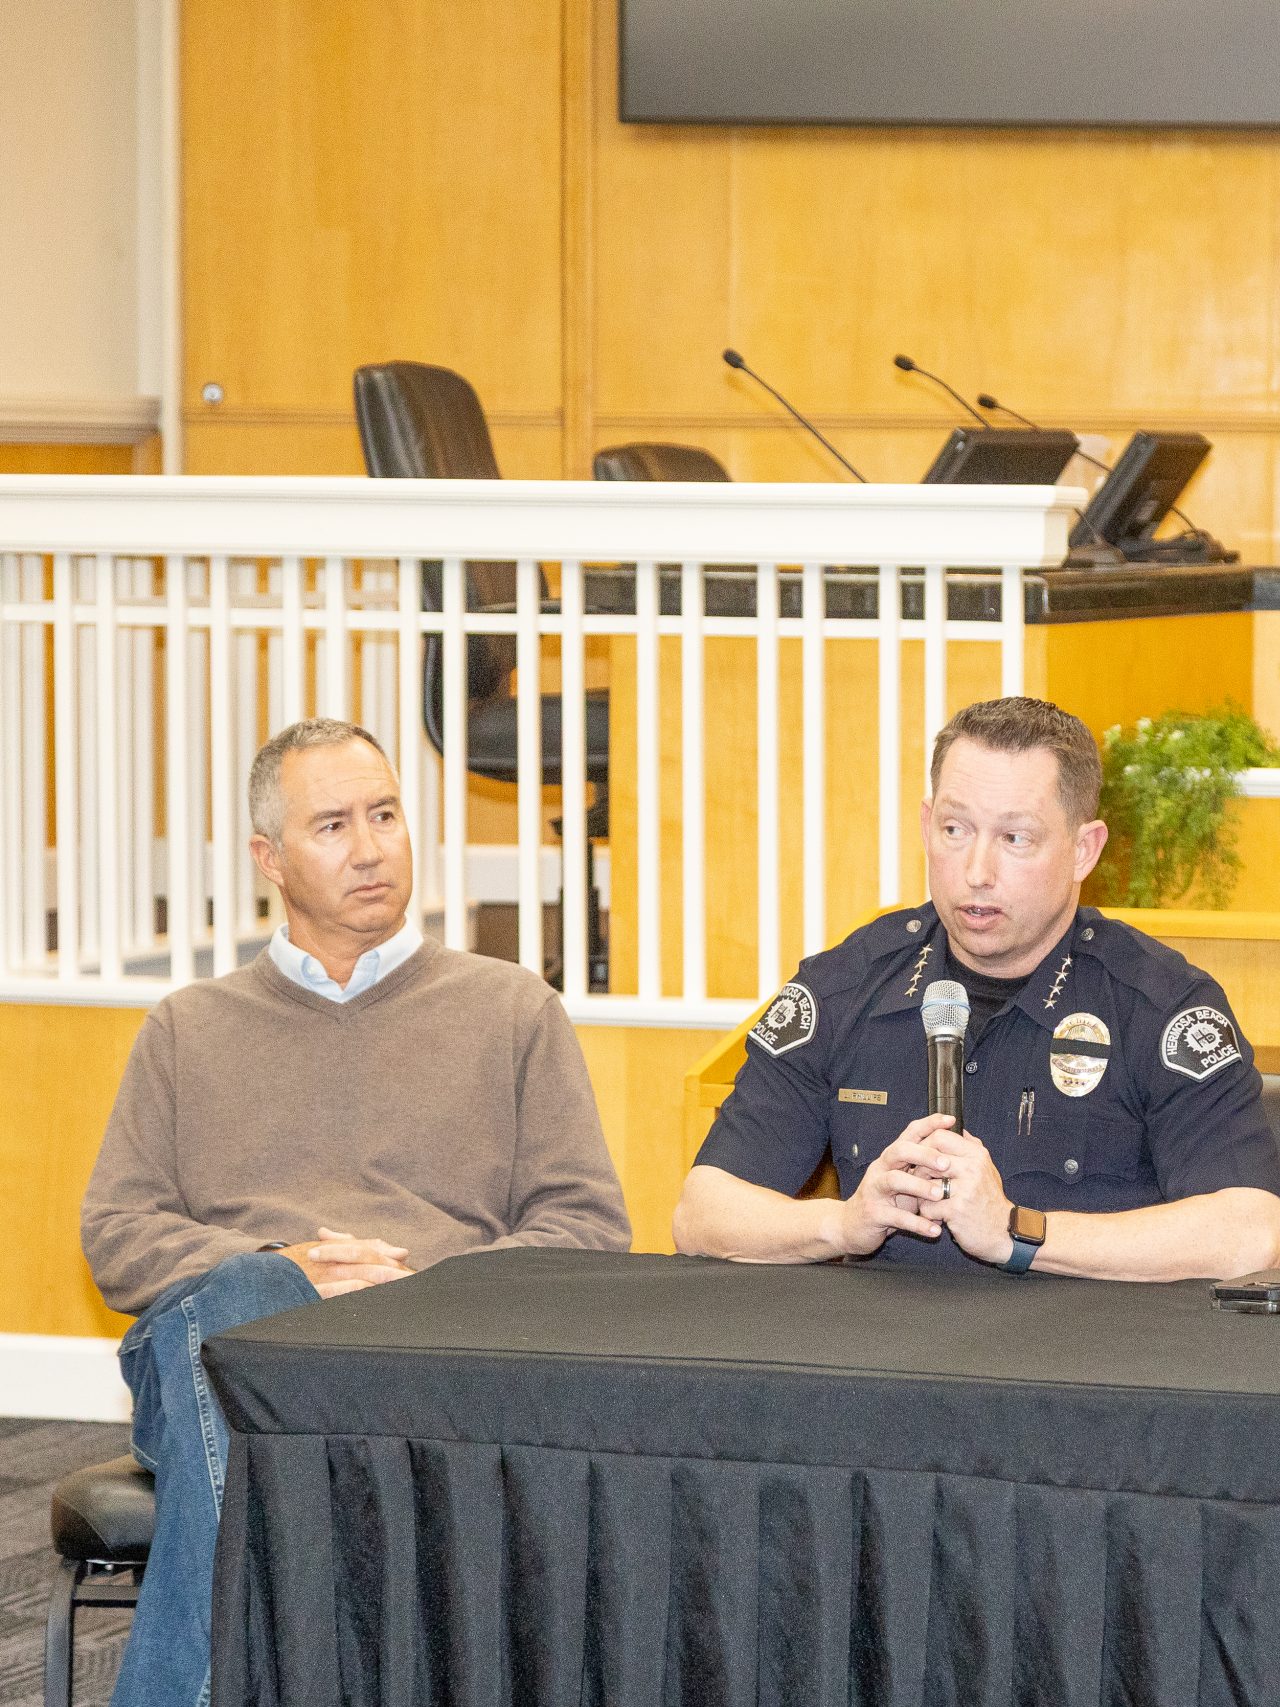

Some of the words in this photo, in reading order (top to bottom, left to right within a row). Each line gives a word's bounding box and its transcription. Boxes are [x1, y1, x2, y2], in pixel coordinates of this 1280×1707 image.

[797, 996, 811, 1030] BEACH
[752, 1022, 779, 1045] POLICE
[1166, 1014, 1196, 1056] HERMOSA
[1195, 1009, 1229, 1027] BEACH
[1200, 1044, 1237, 1068] POLICE
